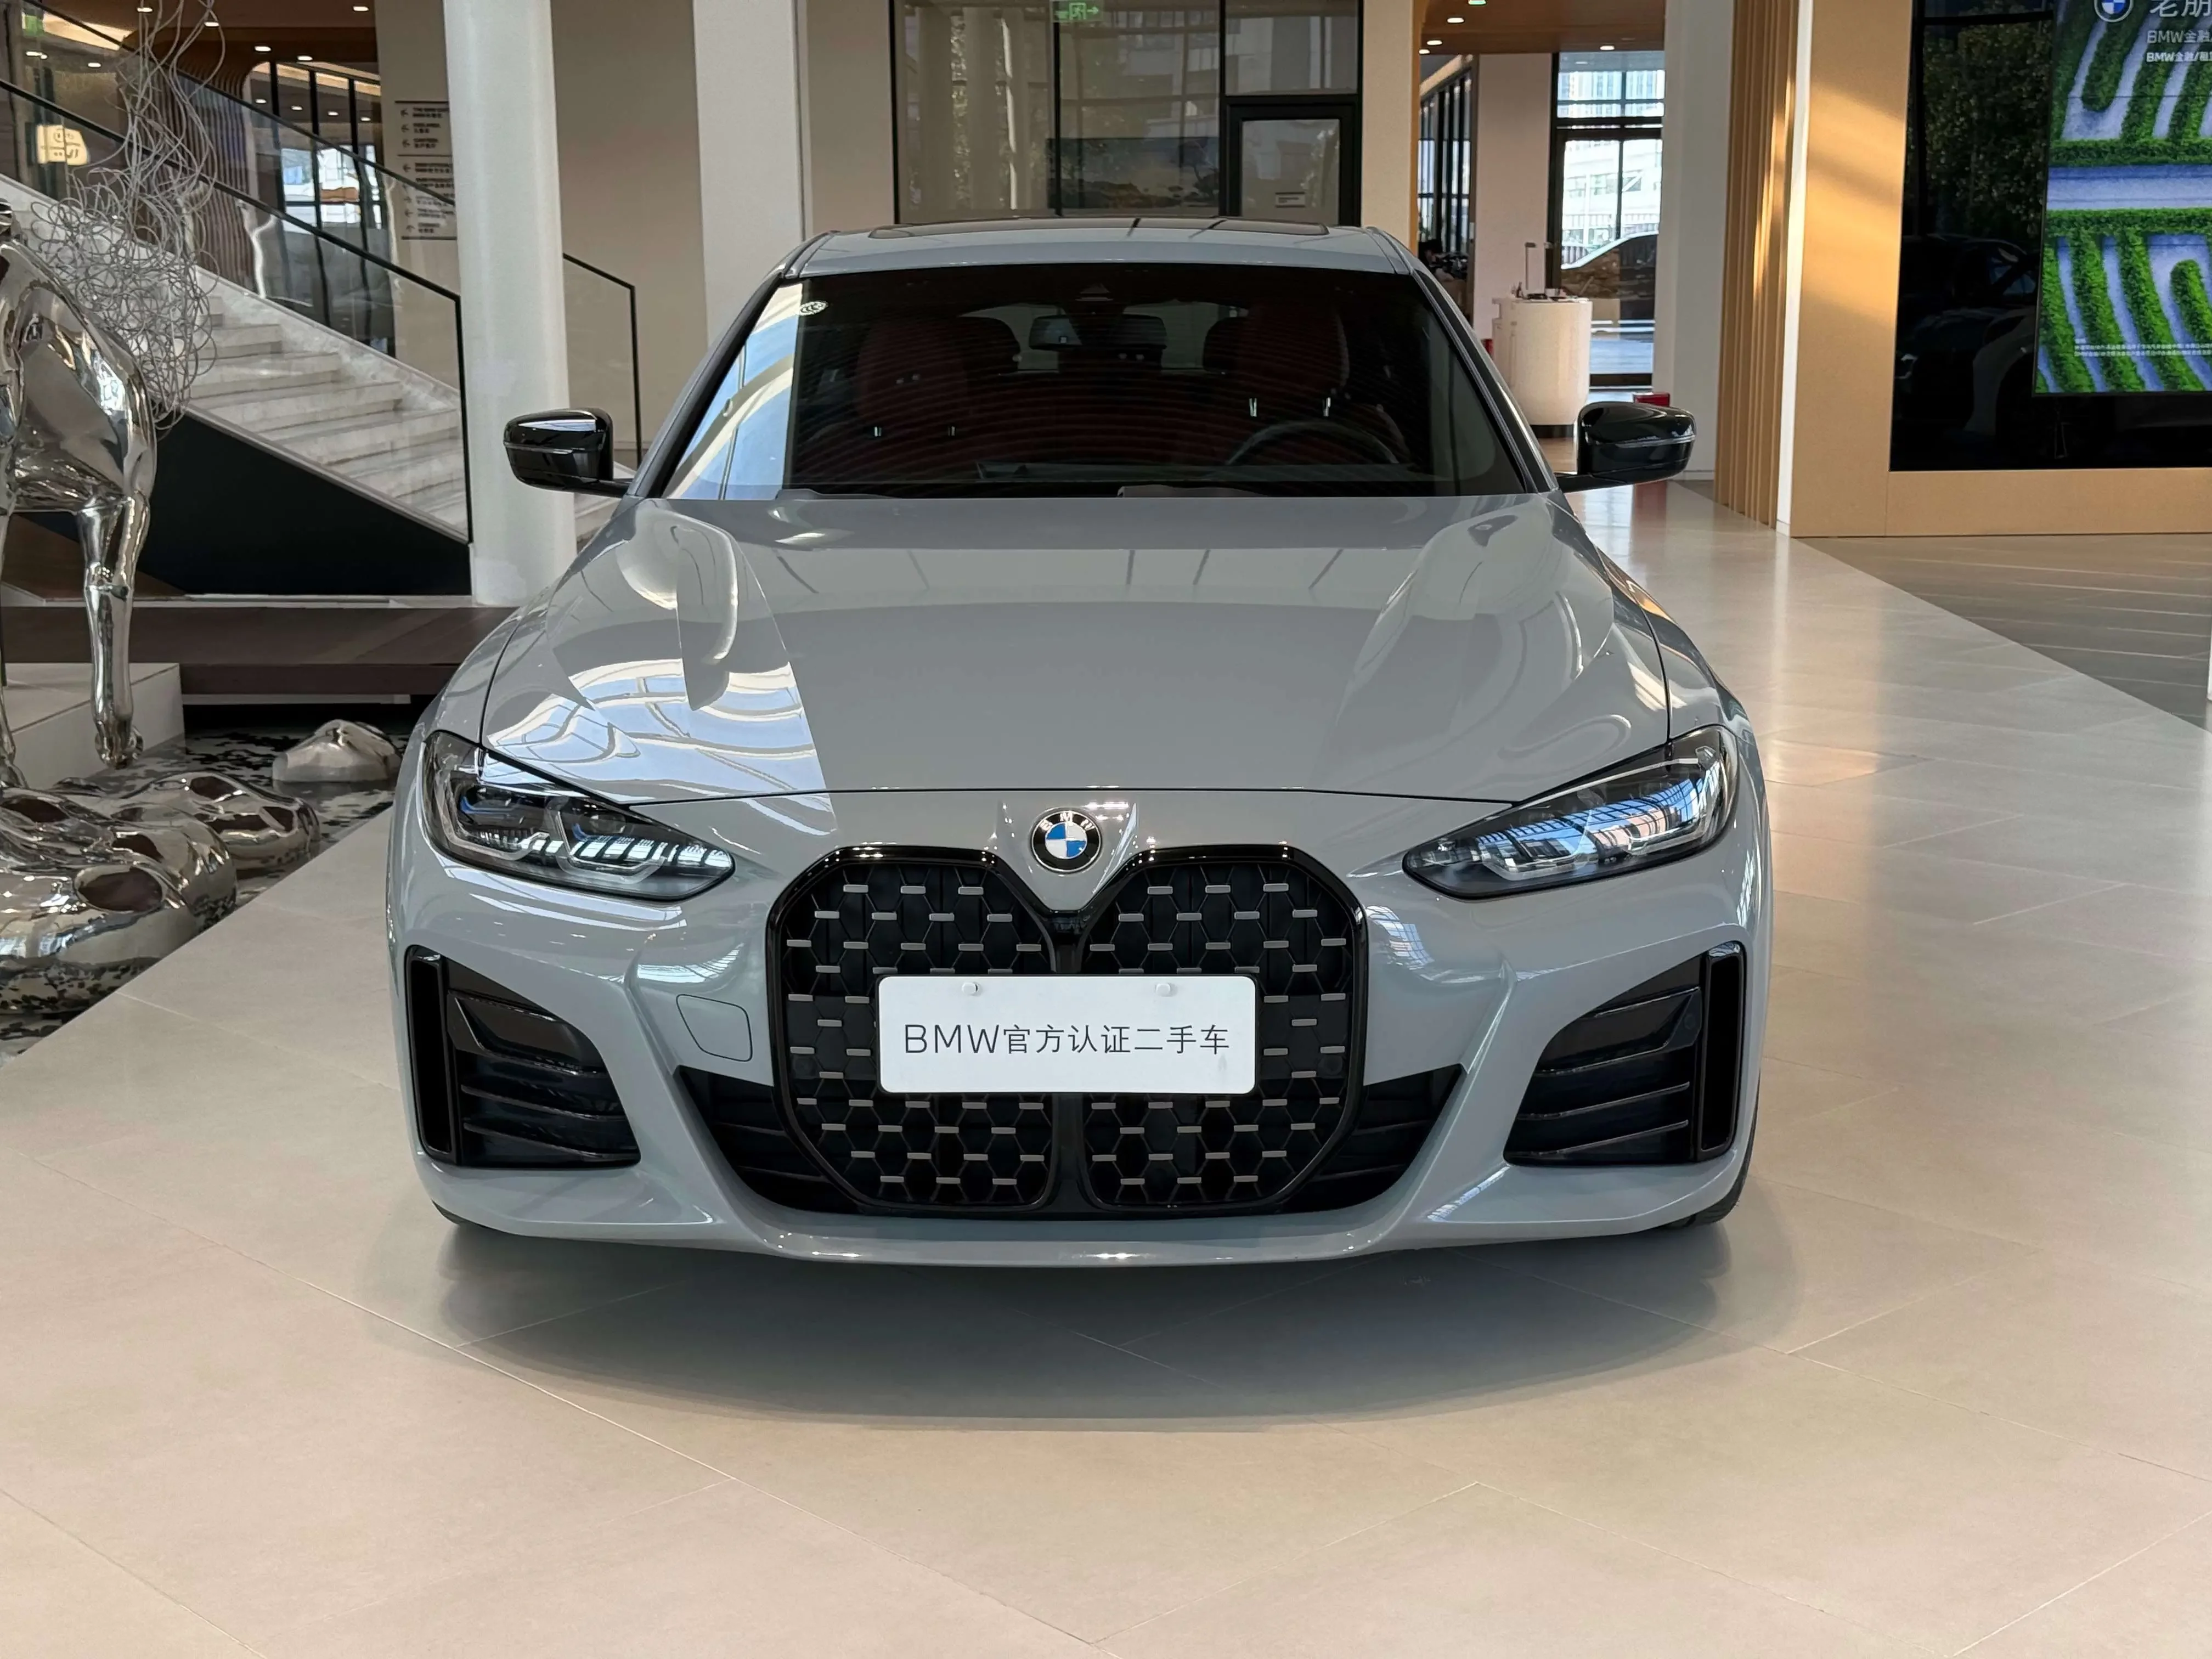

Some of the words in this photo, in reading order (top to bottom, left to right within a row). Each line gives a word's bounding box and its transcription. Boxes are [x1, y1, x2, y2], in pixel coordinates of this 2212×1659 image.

[1040, 811, 1095, 831] BMW
[906, 1025, 1228, 1054] BMW官方认证二手车
